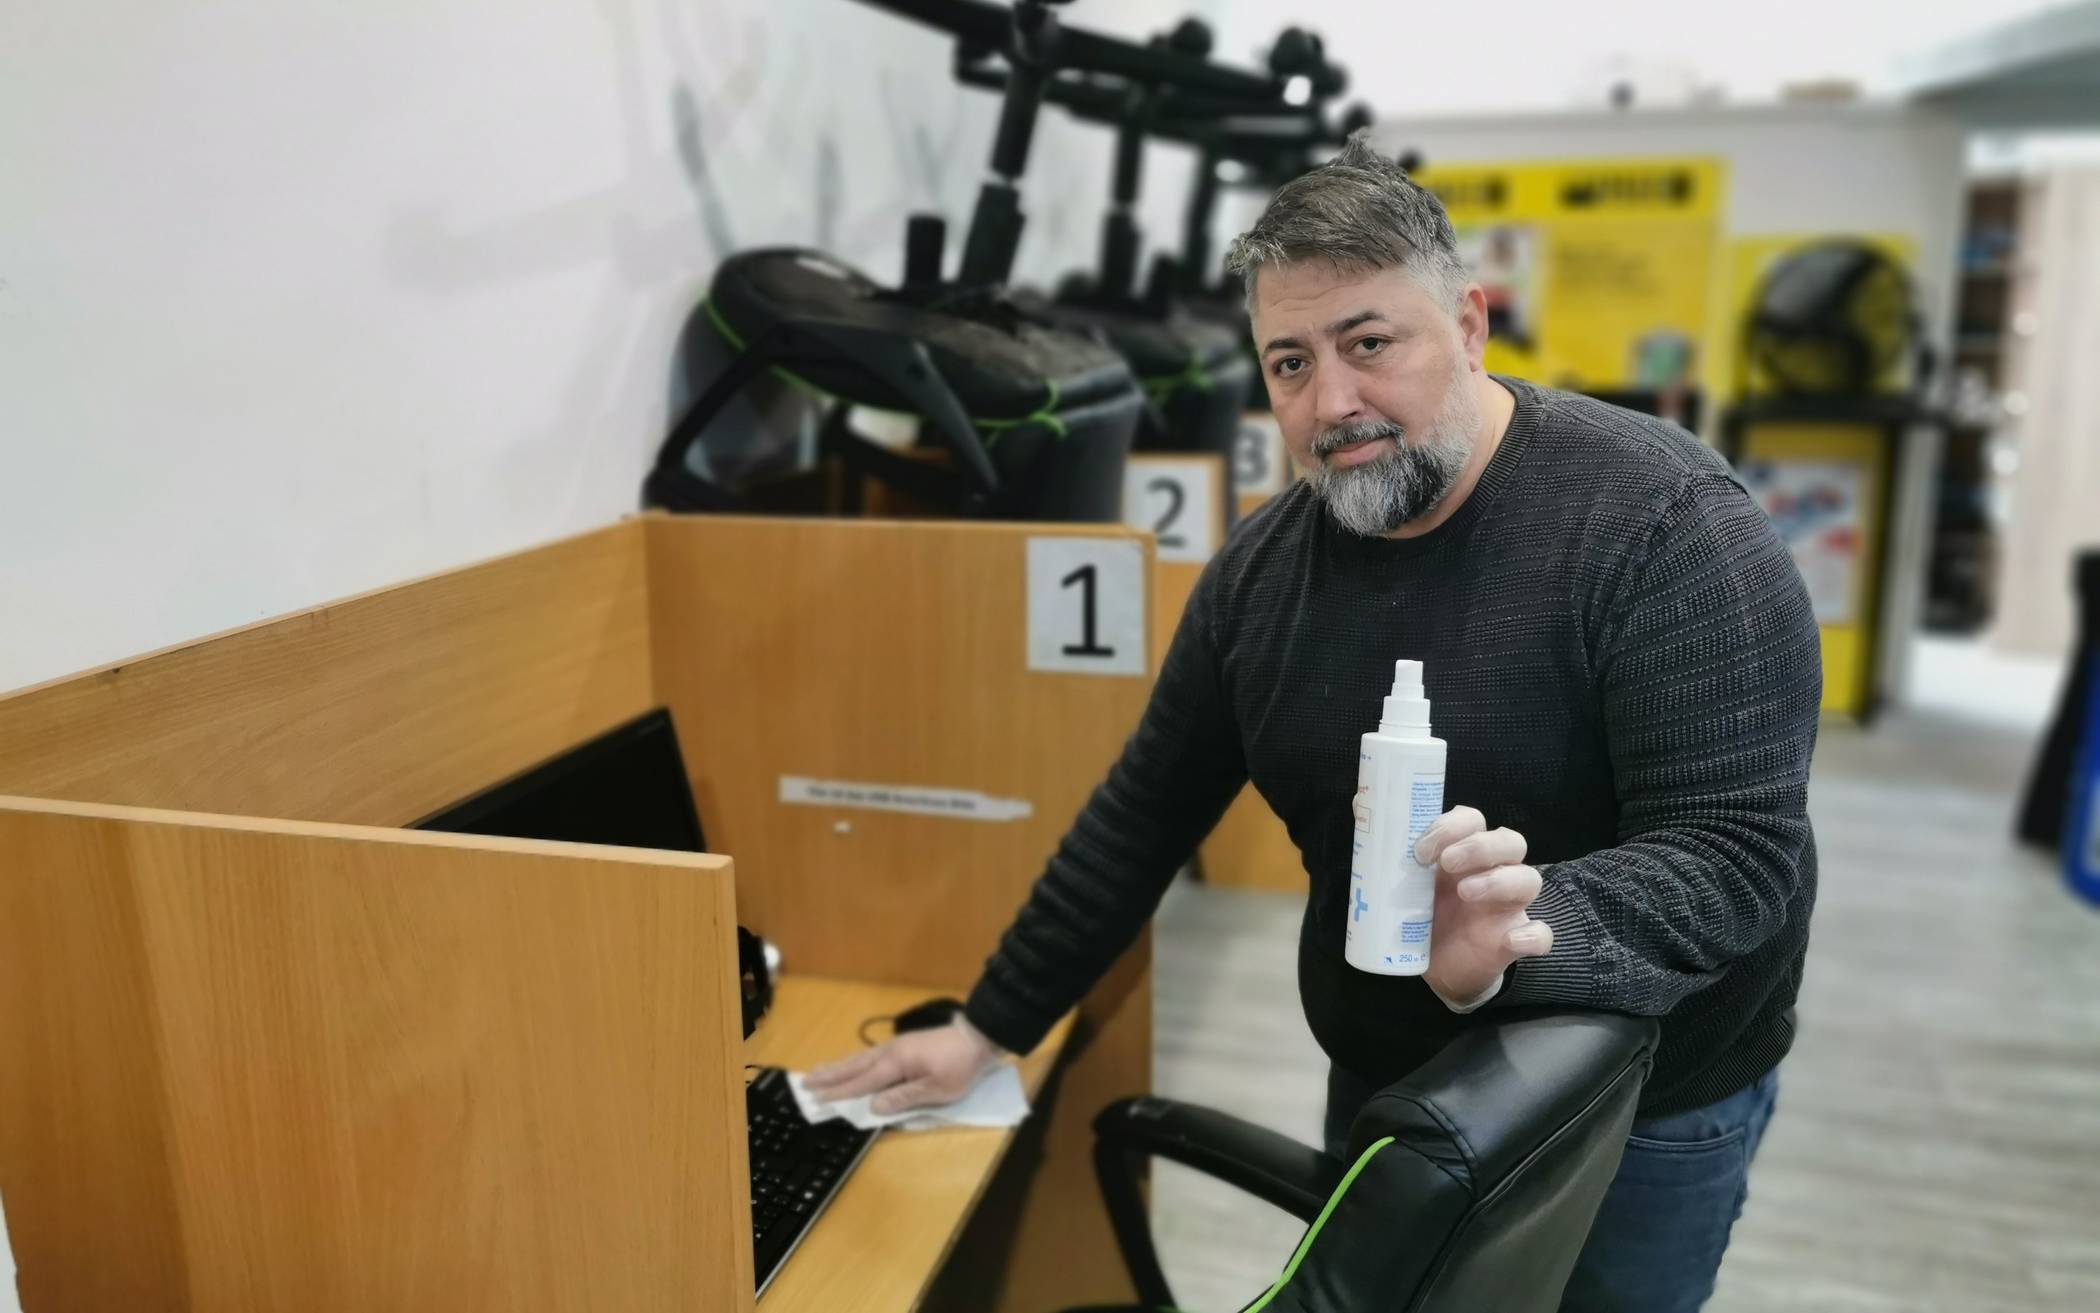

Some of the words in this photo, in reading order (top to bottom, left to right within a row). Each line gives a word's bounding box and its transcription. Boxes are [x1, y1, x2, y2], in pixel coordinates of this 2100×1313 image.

[1234, 424, 1269, 485] 3
[1147, 476, 1187, 548] 2
[1060, 563, 1116, 659] 1
[1399, 954, 1413, 962] 250
